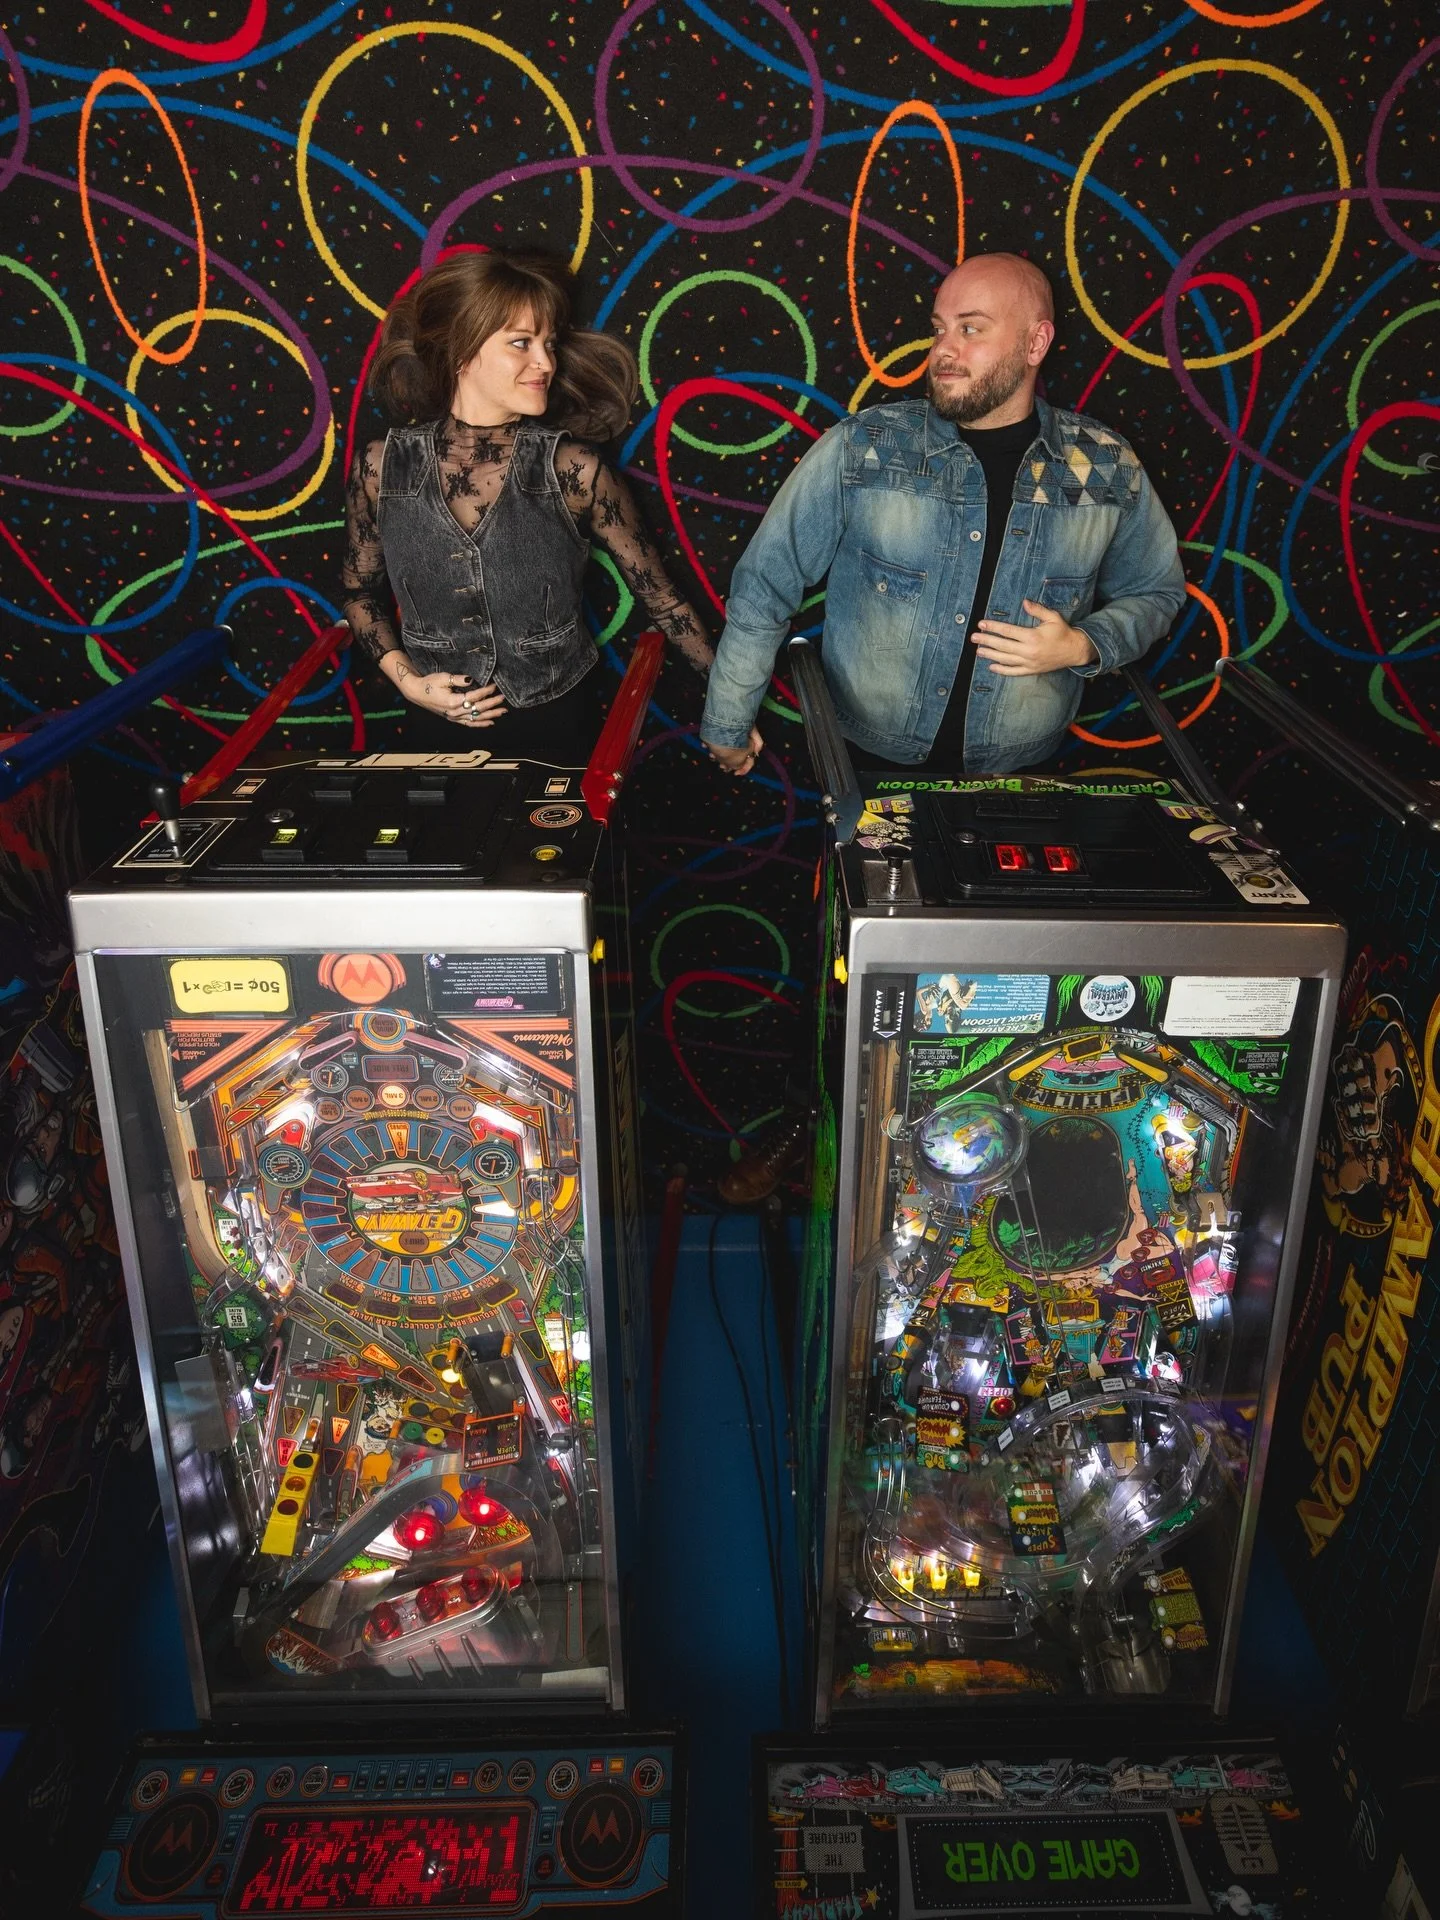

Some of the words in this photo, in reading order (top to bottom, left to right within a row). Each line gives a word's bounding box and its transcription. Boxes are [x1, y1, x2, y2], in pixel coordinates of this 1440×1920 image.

[876, 780, 954, 792] LAGOON
[959, 779, 1023, 794] BLACK
[1065, 780, 1172, 797] CREATURE
[247, 978, 280, 994] 50¢
[1090, 989, 1128, 1001] UNIVERSAL
[960, 1017, 1007, 1026] LAGOON
[1010, 1012, 1043, 1022] BLACK
[968, 1023, 1028, 1033] CREATURE
[512, 1033, 574, 1048] Williams
[361, 1207, 461, 1232] GETAWAY
[1296, 988, 1440, 1558] HAMPION
[348, 1309, 374, 1323] VALUE
[376, 1317, 398, 1327] GEAR
[449, 1316, 467, 1328] RPM
[466, 1308, 499, 1322] REDLINE
[400, 1322, 435, 1330] COLLECT
[1302, 1262, 1378, 1468] PUB
[980, 1387, 1012, 1397] OPEN
[496, 1445, 517, 1455] SUPER
[483, 1453, 513, 1465] SUPERCHARGER
[924, 1452, 946, 1470] BIG
[1027, 1535, 1057, 1553] SUPER
[808, 1831, 857, 1846] CREATURE
[823, 1854, 842, 1866] THE
[942, 1841, 1037, 1884] OVER
[1043, 1838, 1141, 1881] GAME
